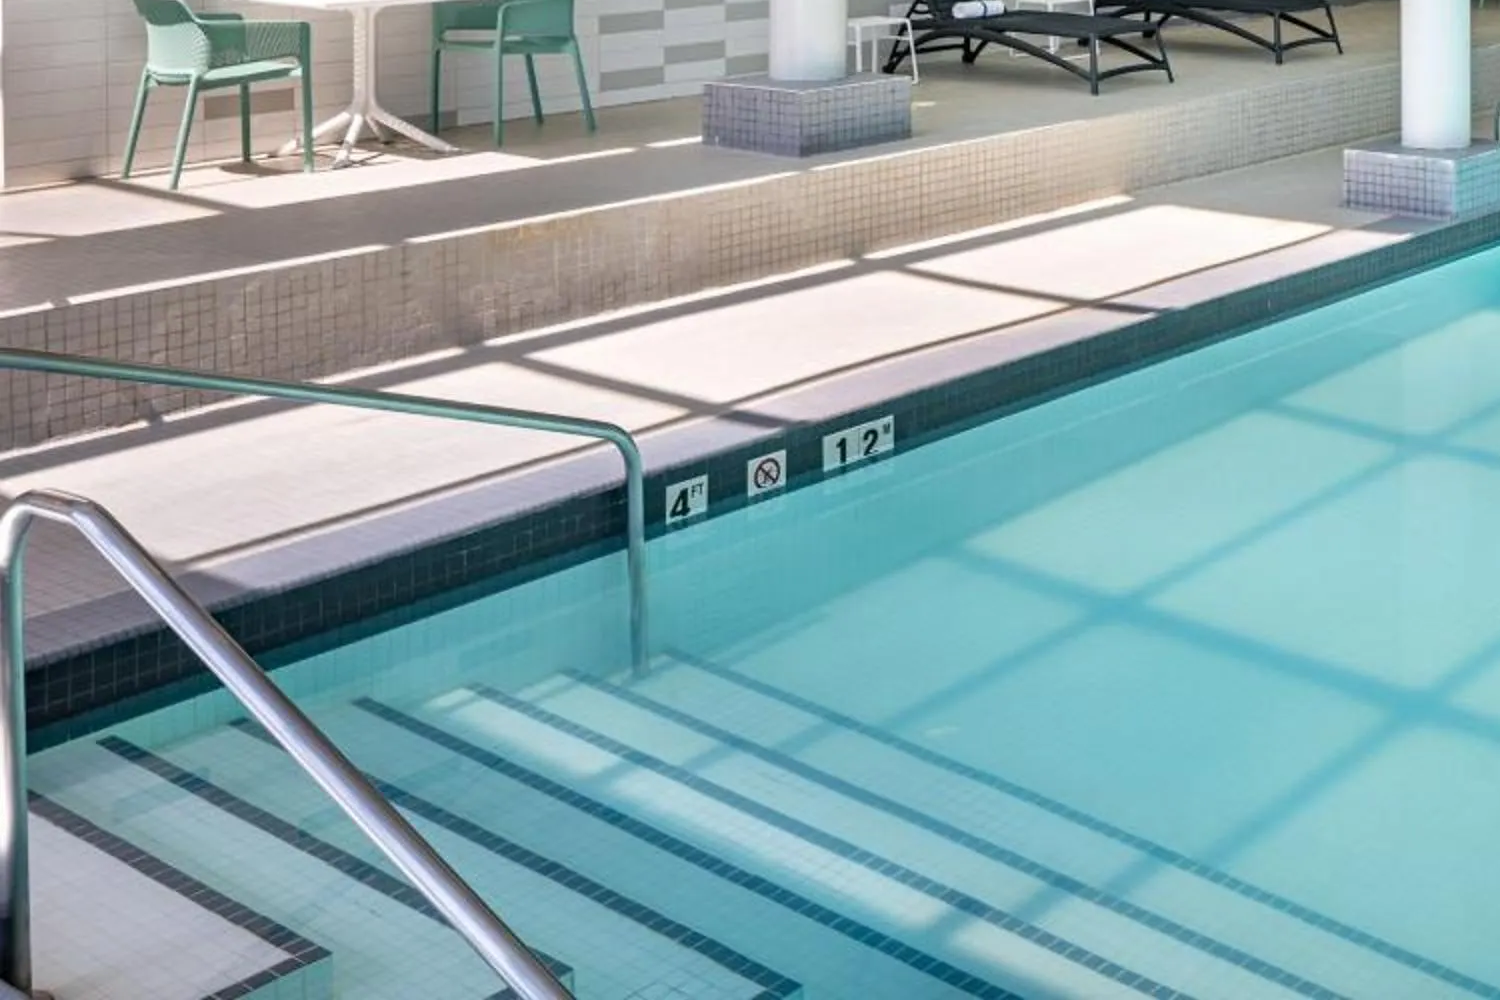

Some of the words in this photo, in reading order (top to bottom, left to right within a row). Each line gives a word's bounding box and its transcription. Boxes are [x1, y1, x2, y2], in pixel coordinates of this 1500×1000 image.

[862, 428, 879, 456] 2
[669, 486, 691, 518] 4
[691, 482, 705, 497] FT
